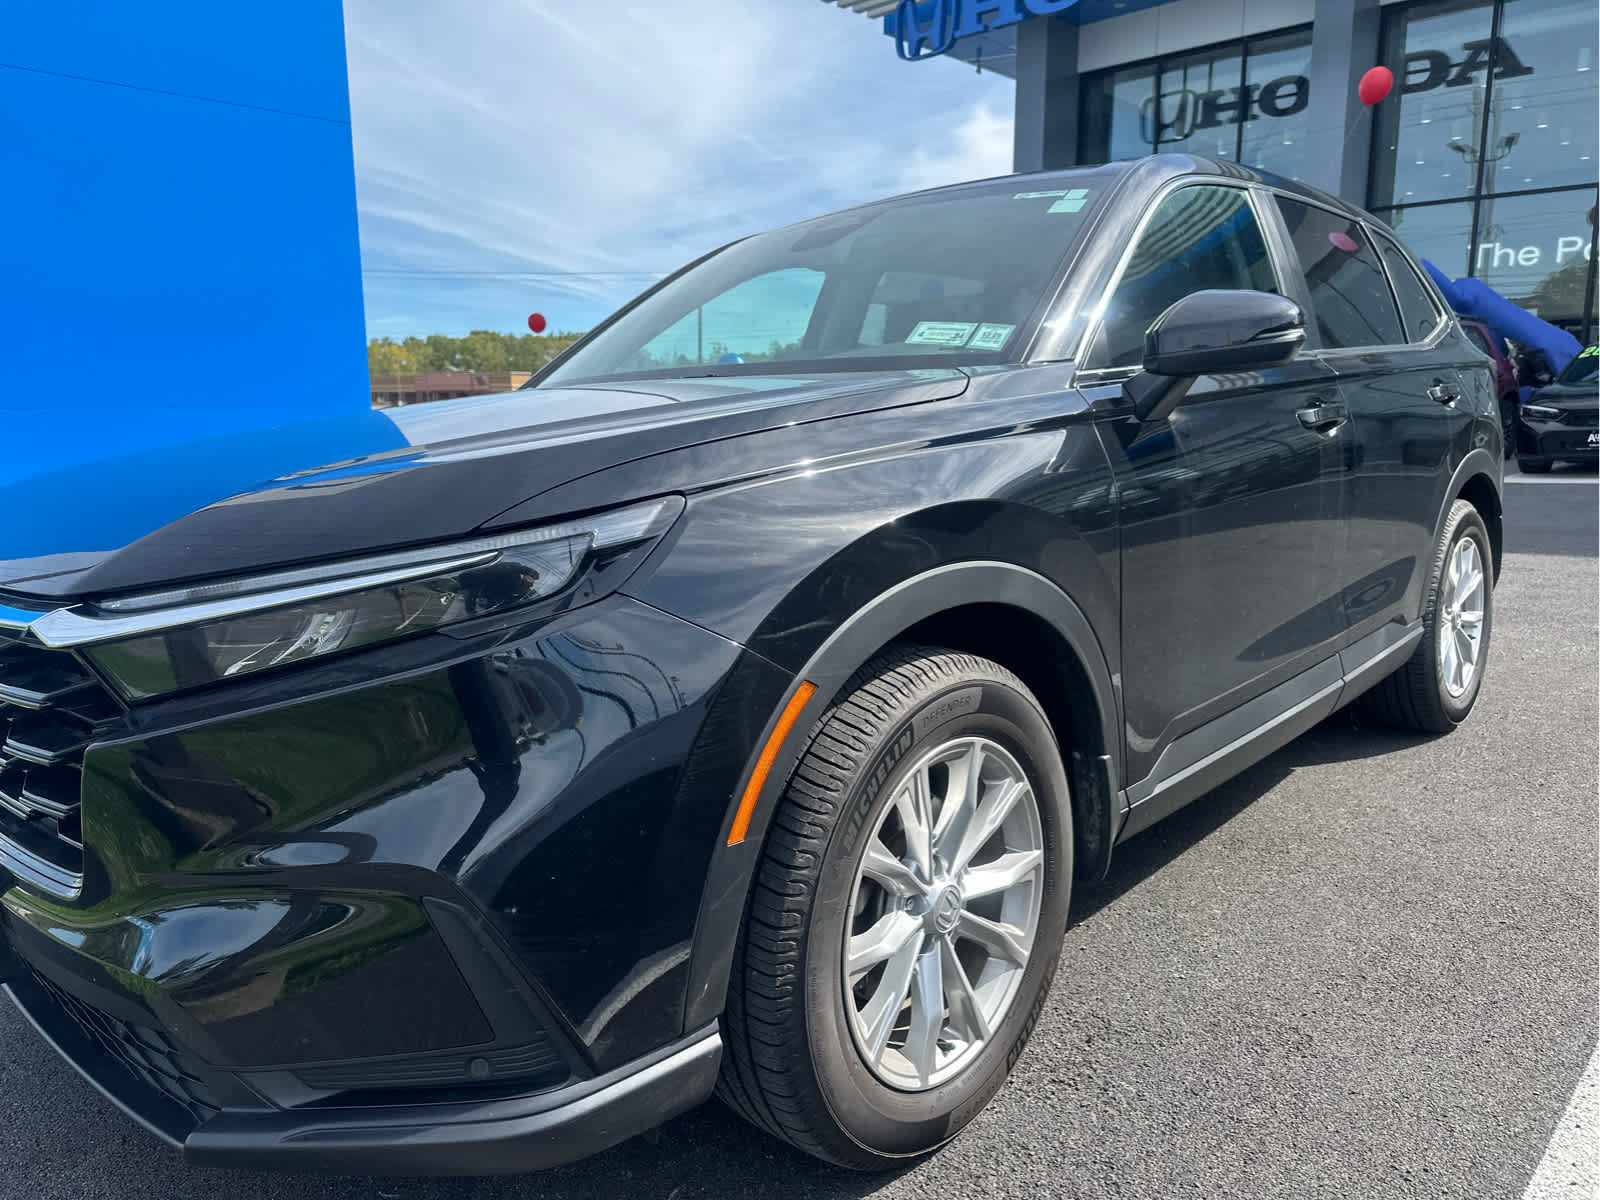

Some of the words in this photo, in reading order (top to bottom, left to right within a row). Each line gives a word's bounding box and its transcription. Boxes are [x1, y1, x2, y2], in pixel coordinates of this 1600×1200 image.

[1467, 241, 1540, 269] The
[842, 727, 914, 850] MICHELIN
[921, 694, 973, 729] DEFENDER
